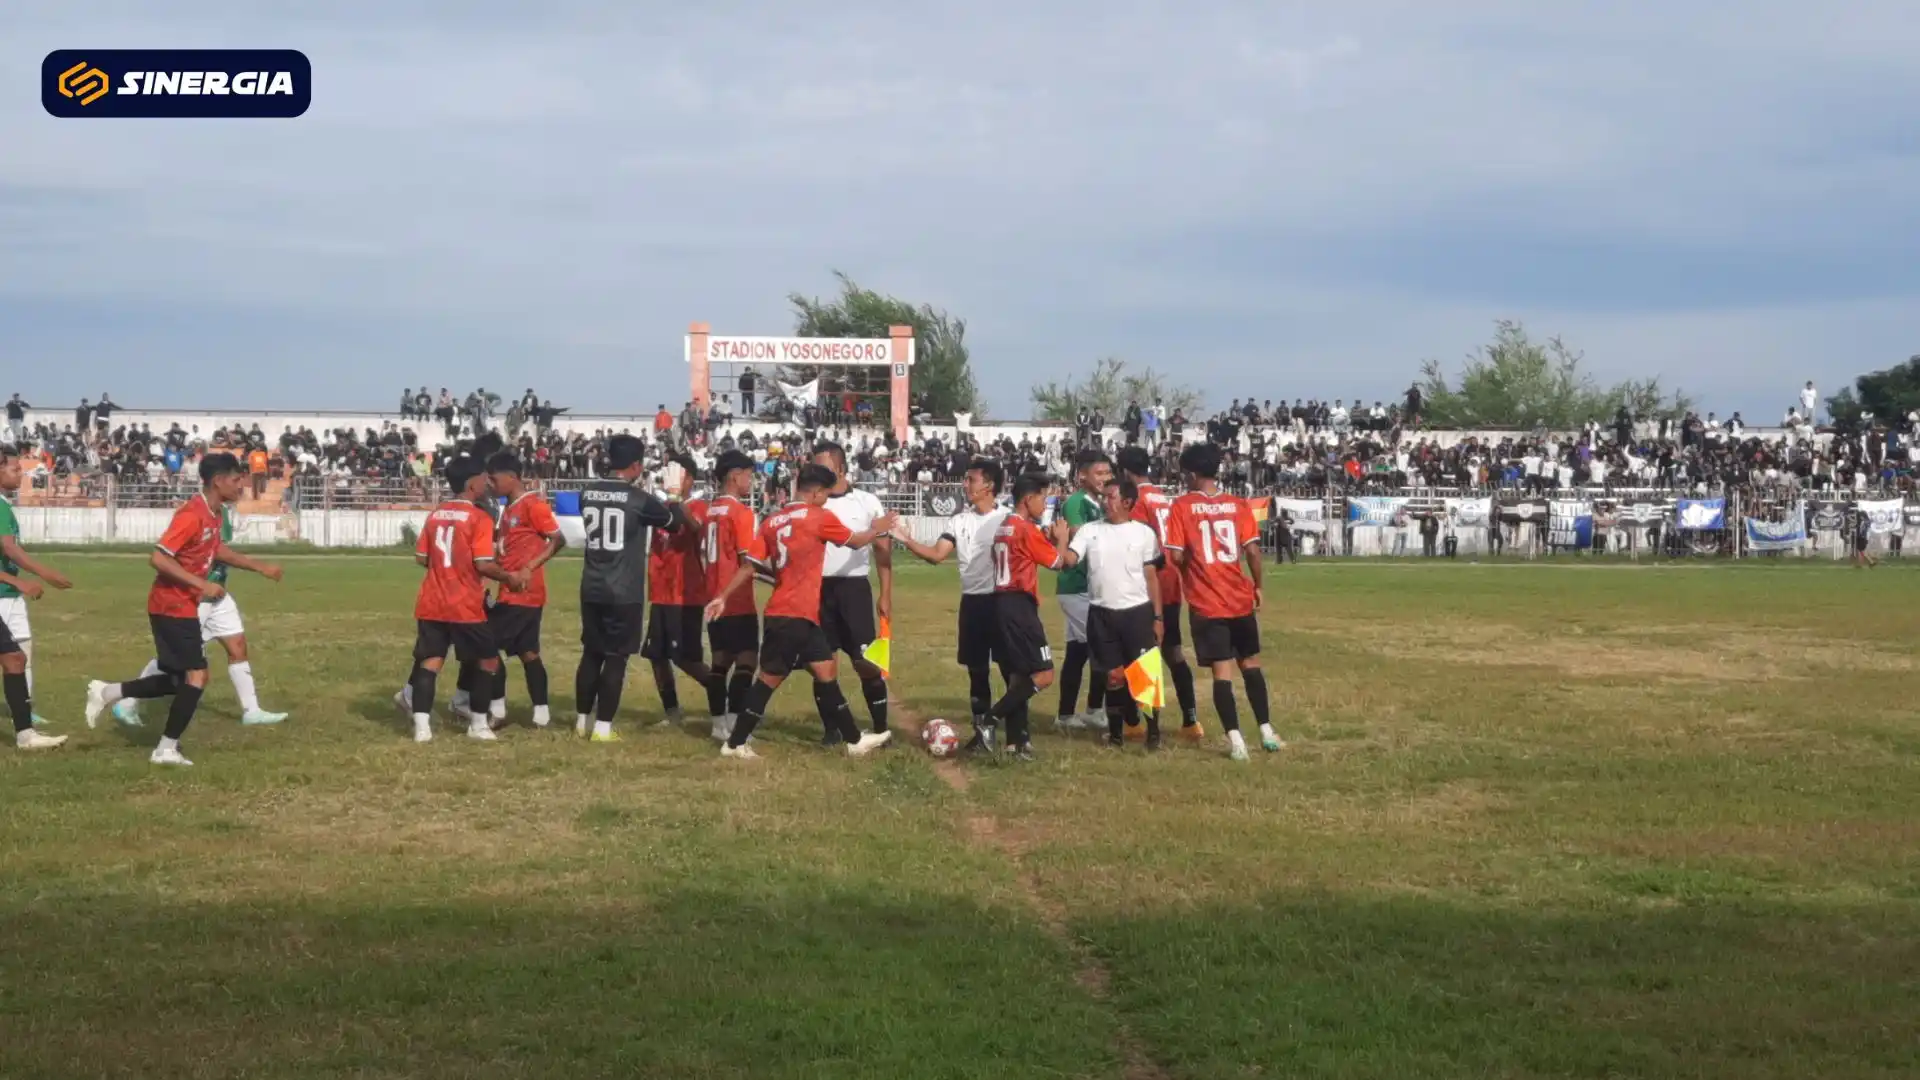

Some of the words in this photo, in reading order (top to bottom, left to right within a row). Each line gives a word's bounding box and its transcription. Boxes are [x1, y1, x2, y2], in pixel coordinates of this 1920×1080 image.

[710, 341, 776, 360] STADION
[781, 343, 887, 360] YOSONEGORO
[435, 525, 454, 569] 4
[583, 506, 625, 551] 20
[776, 524, 793, 569] 5
[1199, 519, 1237, 564] 19
